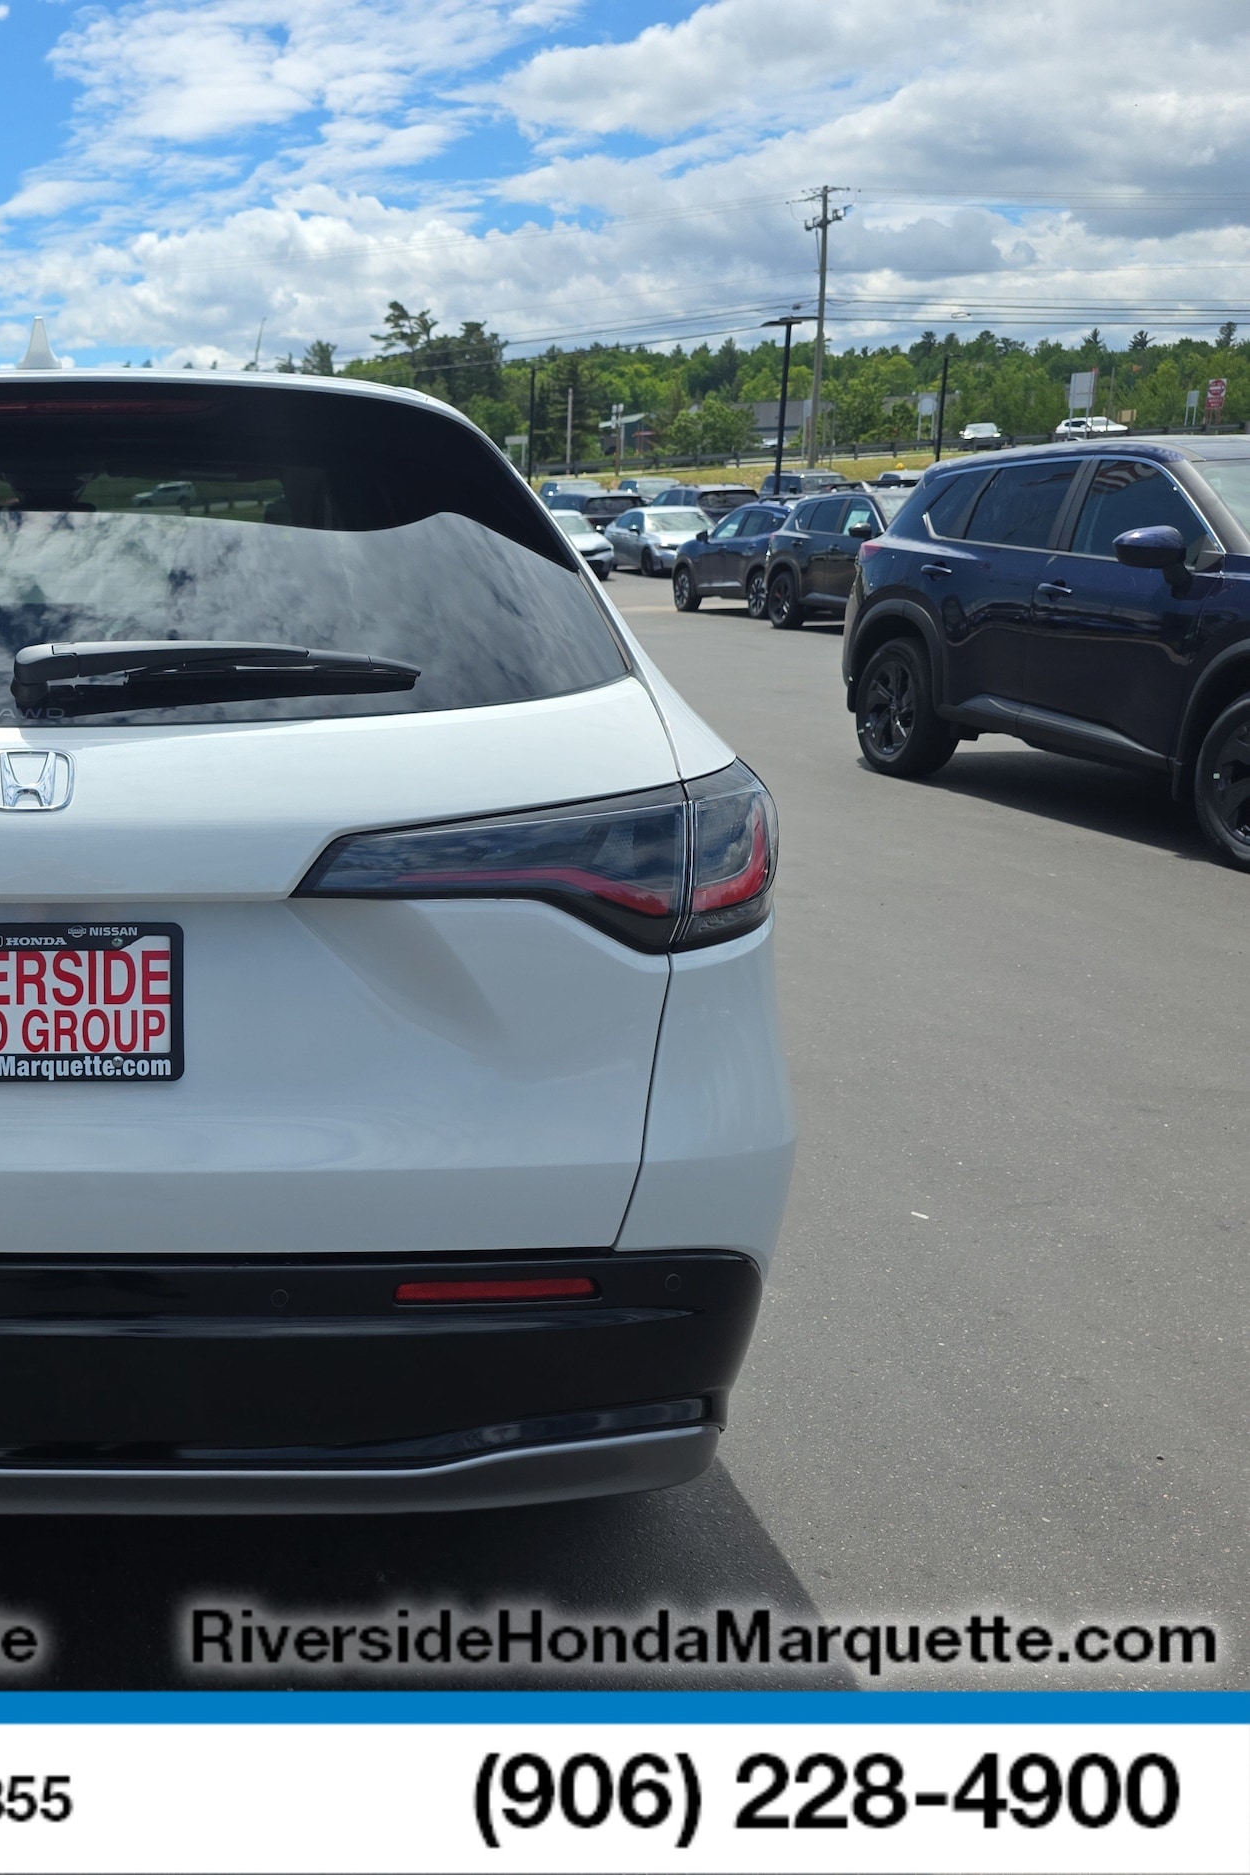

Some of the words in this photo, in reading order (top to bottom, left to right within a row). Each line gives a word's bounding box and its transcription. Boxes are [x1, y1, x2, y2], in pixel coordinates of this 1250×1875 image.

[89, 926, 138, 937] NISSAN
[5, 936, 67, 946] HONDA
[21, 1008, 166, 1053] GROUP
